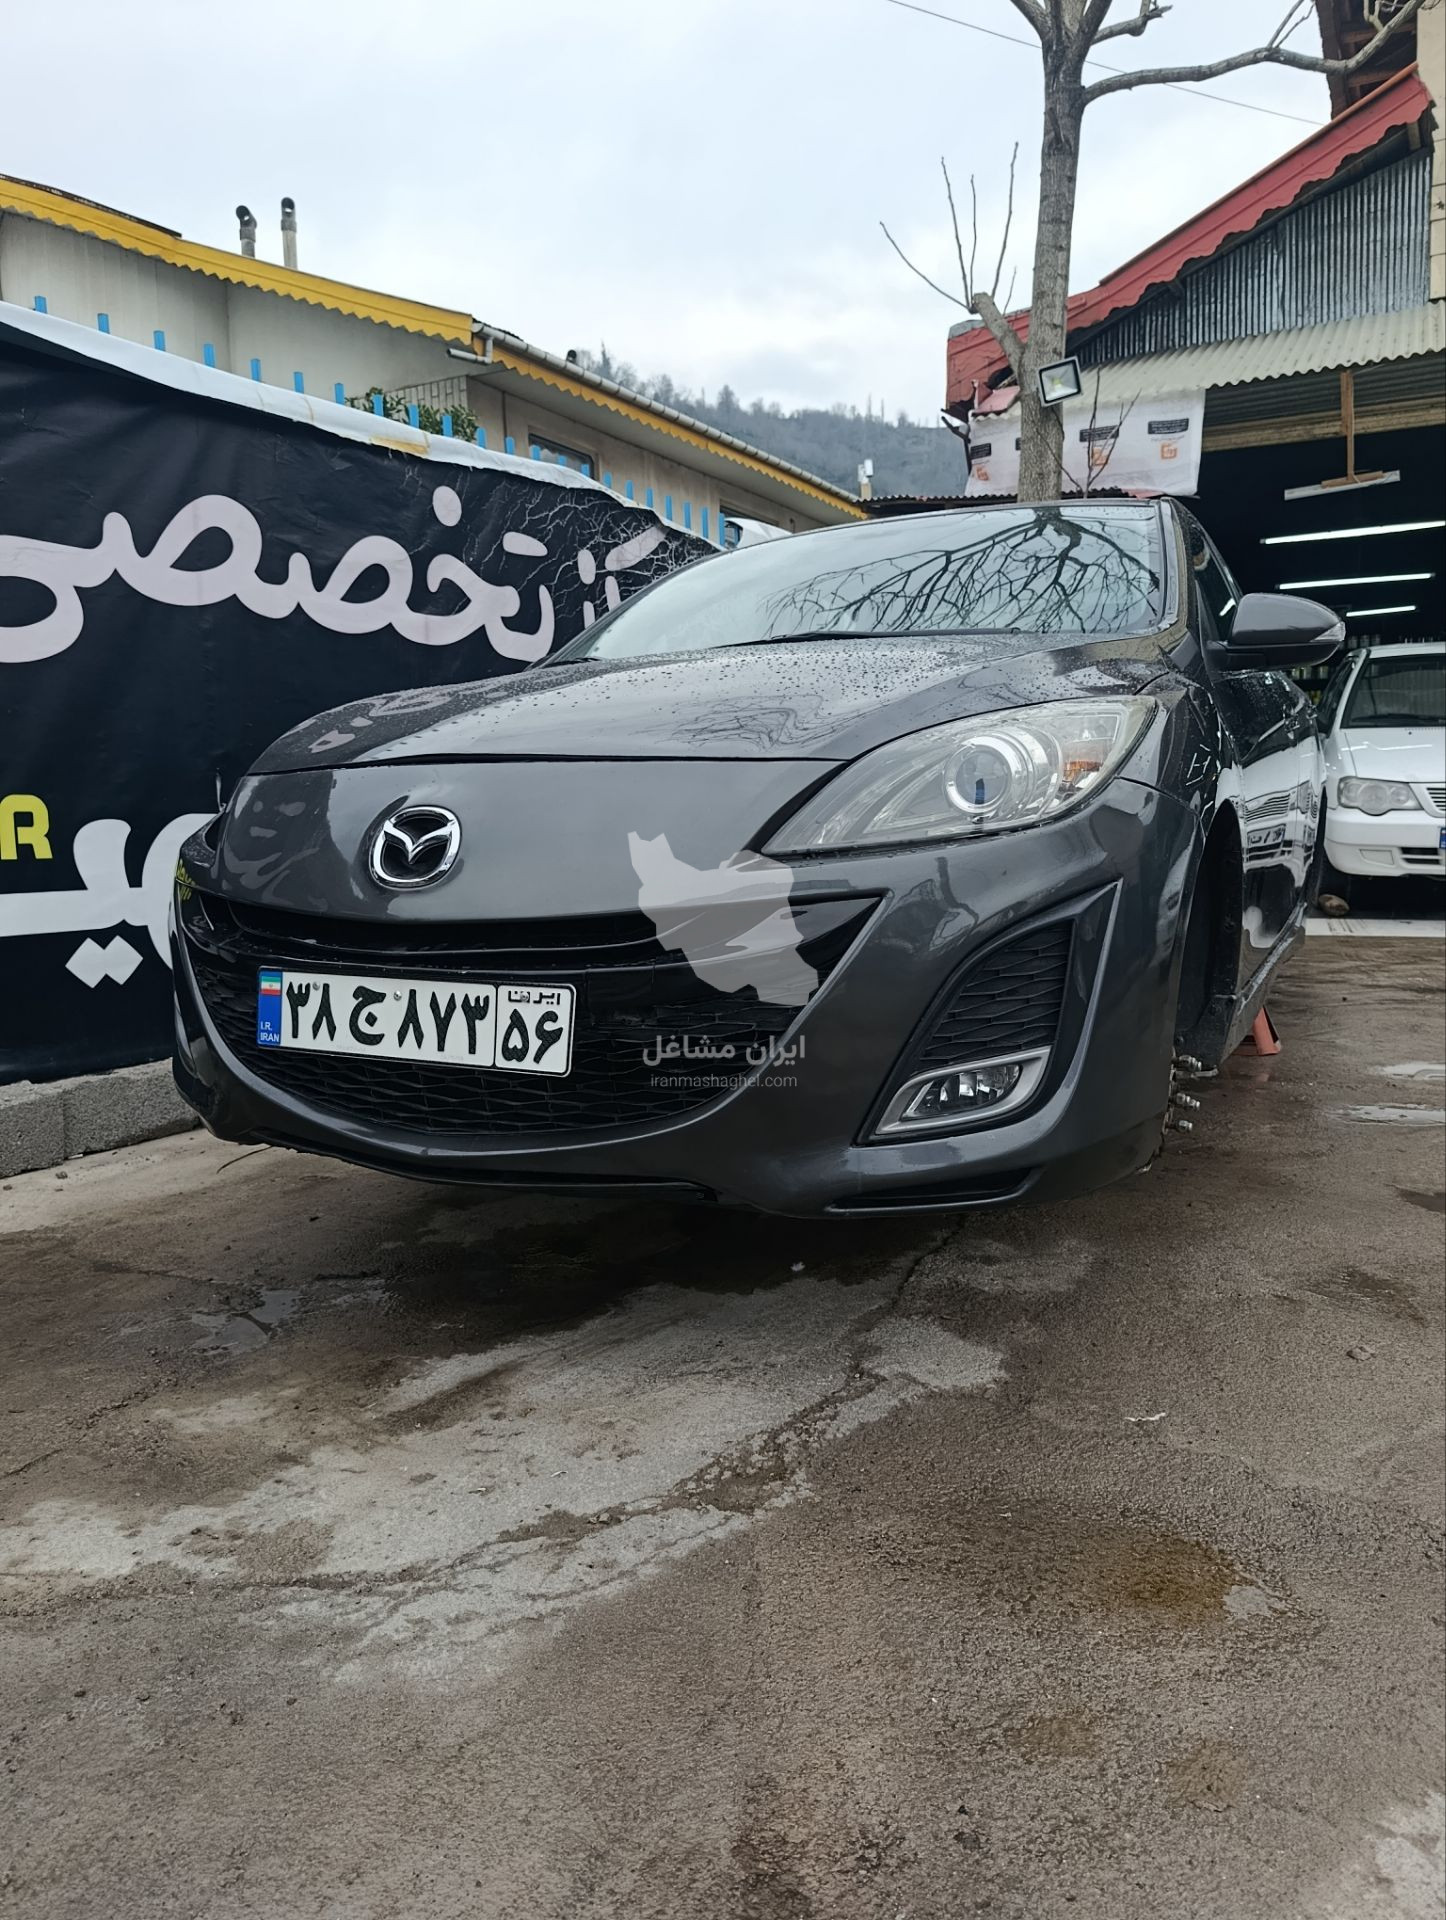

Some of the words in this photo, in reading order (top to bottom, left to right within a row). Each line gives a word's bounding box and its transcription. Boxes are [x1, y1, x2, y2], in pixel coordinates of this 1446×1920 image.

[508, 990, 561, 1006] ایران
[260, 1021, 273, 1031] I.R.
[260, 1032, 280, 1042] IRAN
[501, 1008, 564, 1065] ۵۶
